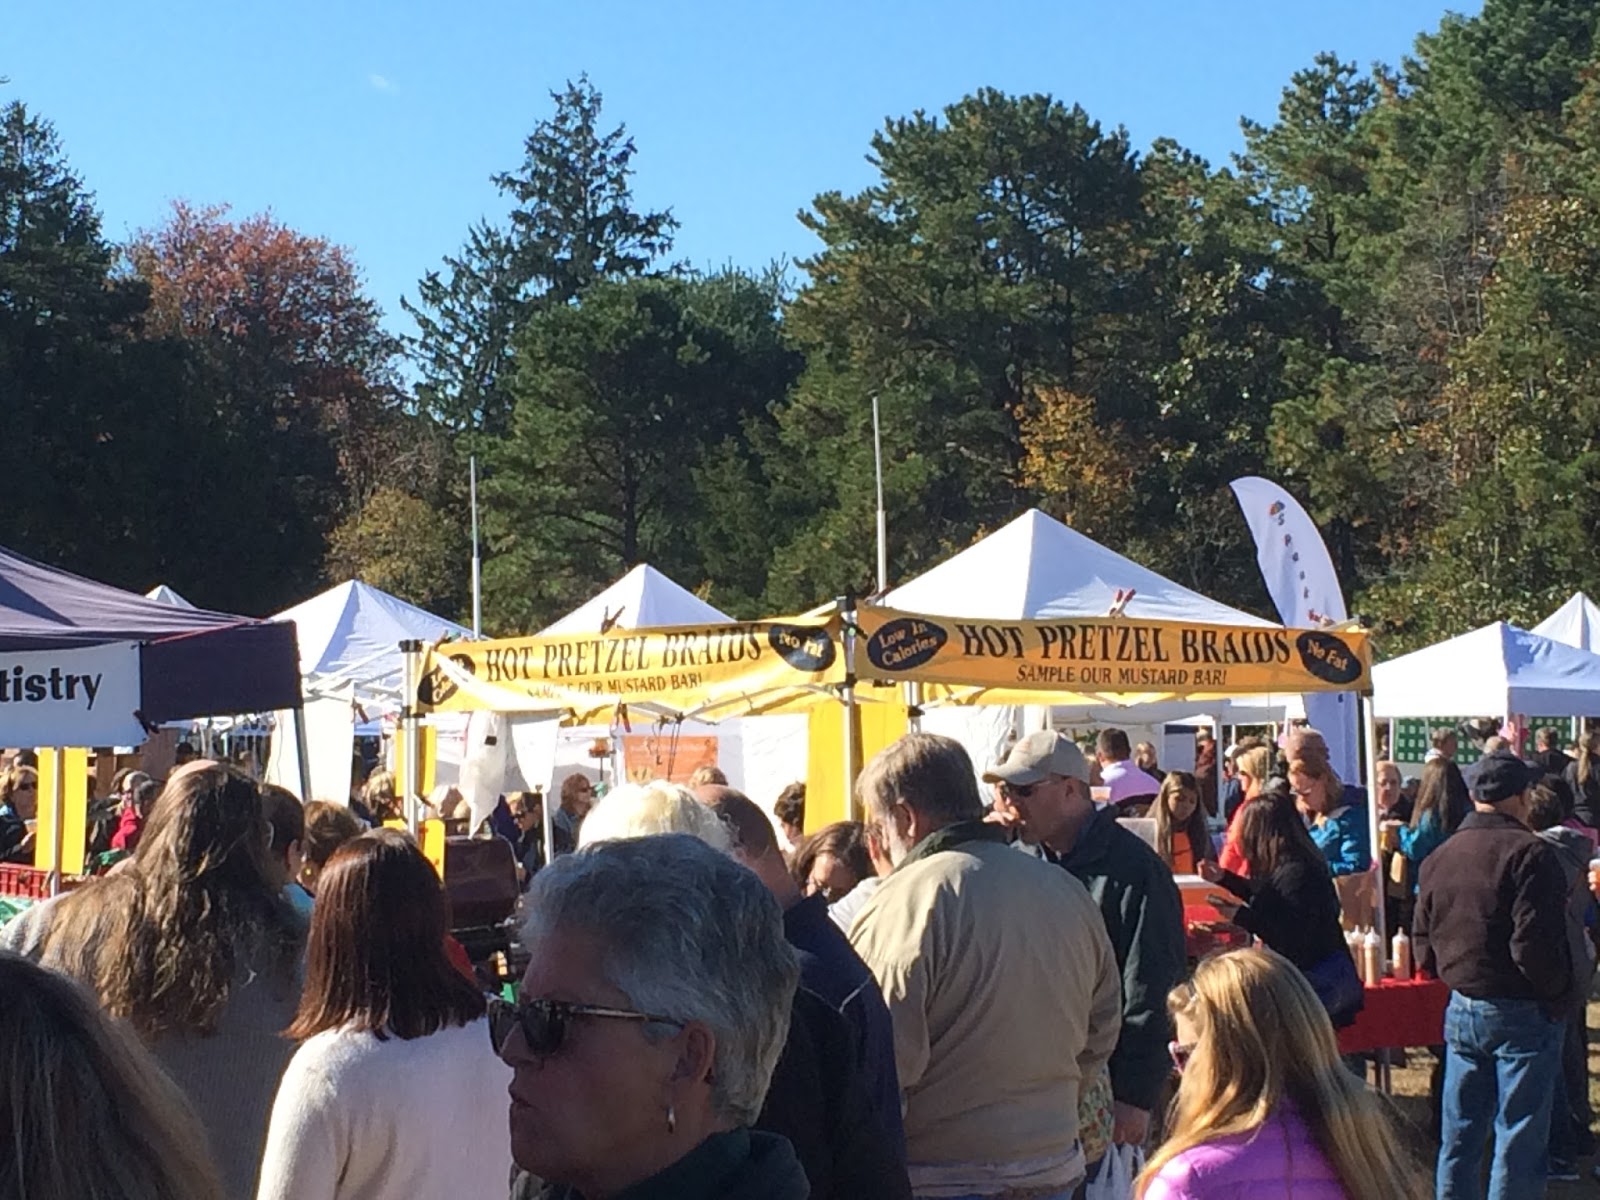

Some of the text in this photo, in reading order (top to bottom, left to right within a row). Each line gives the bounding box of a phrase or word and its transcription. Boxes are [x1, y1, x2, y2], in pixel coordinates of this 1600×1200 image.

[779, 631, 800, 648] No
[879, 622, 928, 648] Low In
[956, 624, 1291, 664] HOT PRETZEL BRAIDS
[485, 646, 534, 682] HOT
[543, 634, 651, 680] PRETZEL
[662, 624, 762, 668] BRAIDS
[881, 636, 938, 666] Calories
[1307, 639, 1348, 671] No Fat
[607, 676, 666, 694] MUSTARD
[671, 673, 703, 690] BAR!
[1017, 664, 1227, 686] SAMPLE OUR MUSTARD BAR!
